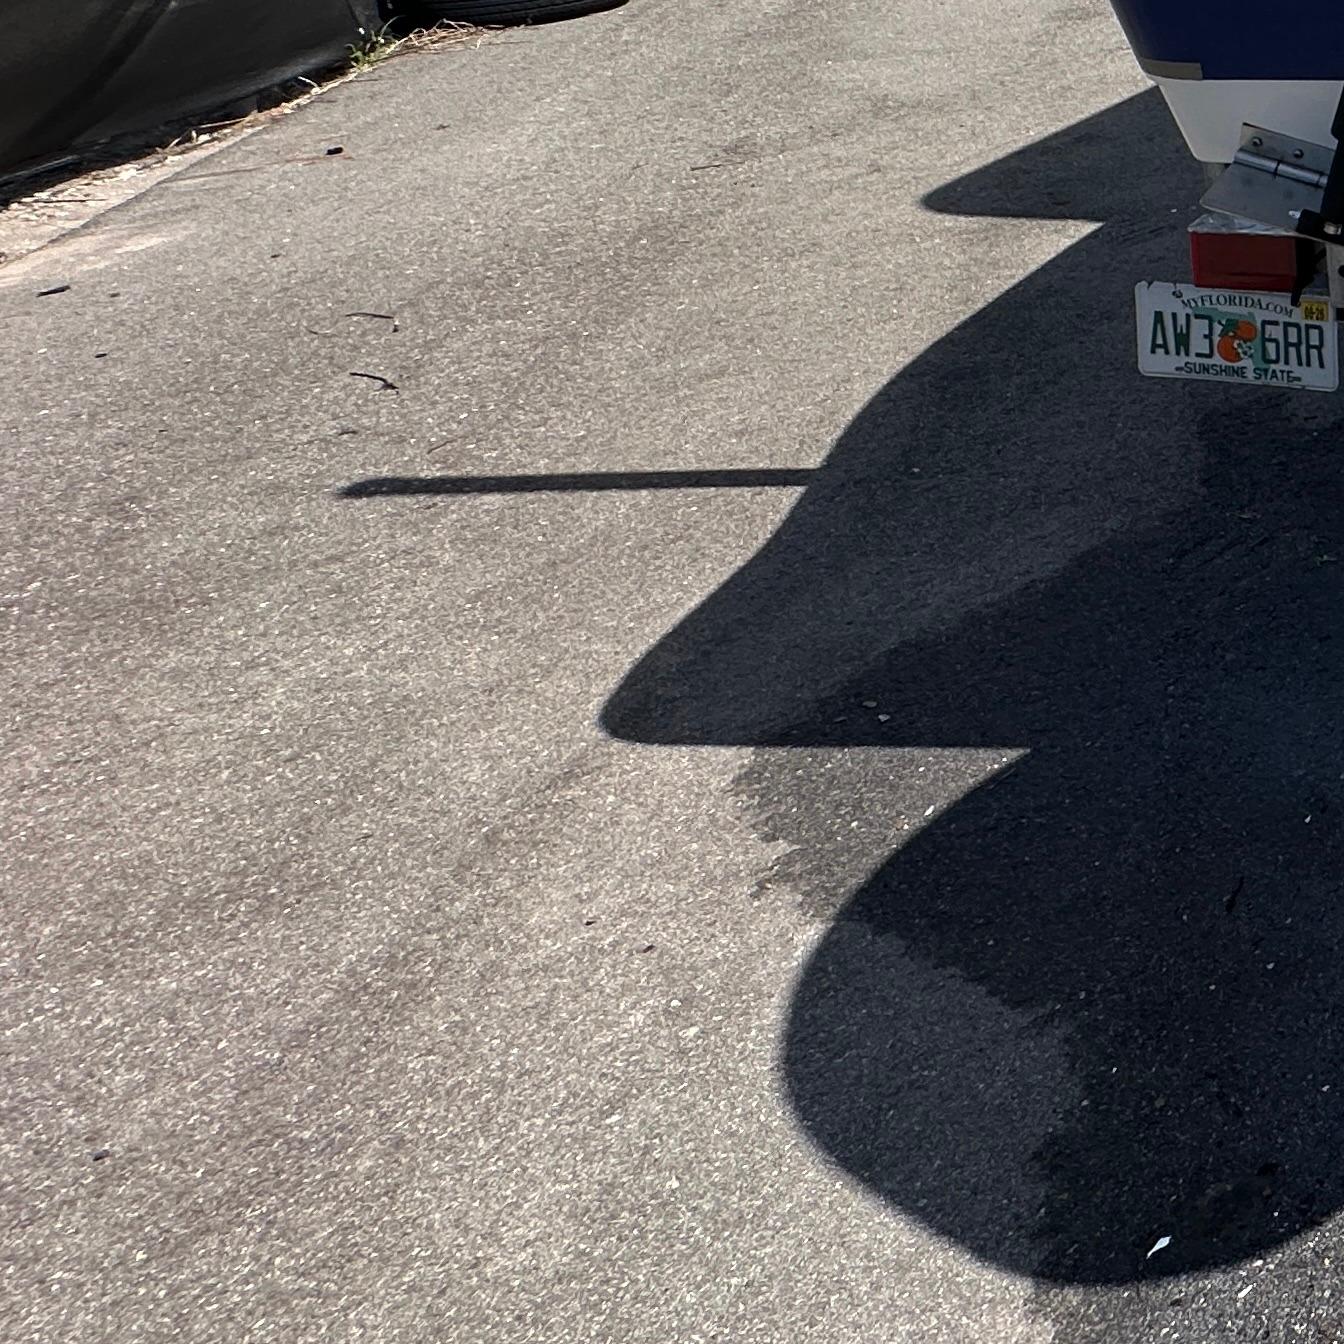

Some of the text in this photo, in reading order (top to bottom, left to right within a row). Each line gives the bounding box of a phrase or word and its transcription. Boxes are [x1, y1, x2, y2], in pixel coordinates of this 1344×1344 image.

[1181, 293, 1294, 318] MYFLORIDA.COM
[1150, 310, 1325, 369] AW3 6RR
[1184, 361, 1295, 383] SUNSHINE STATE
